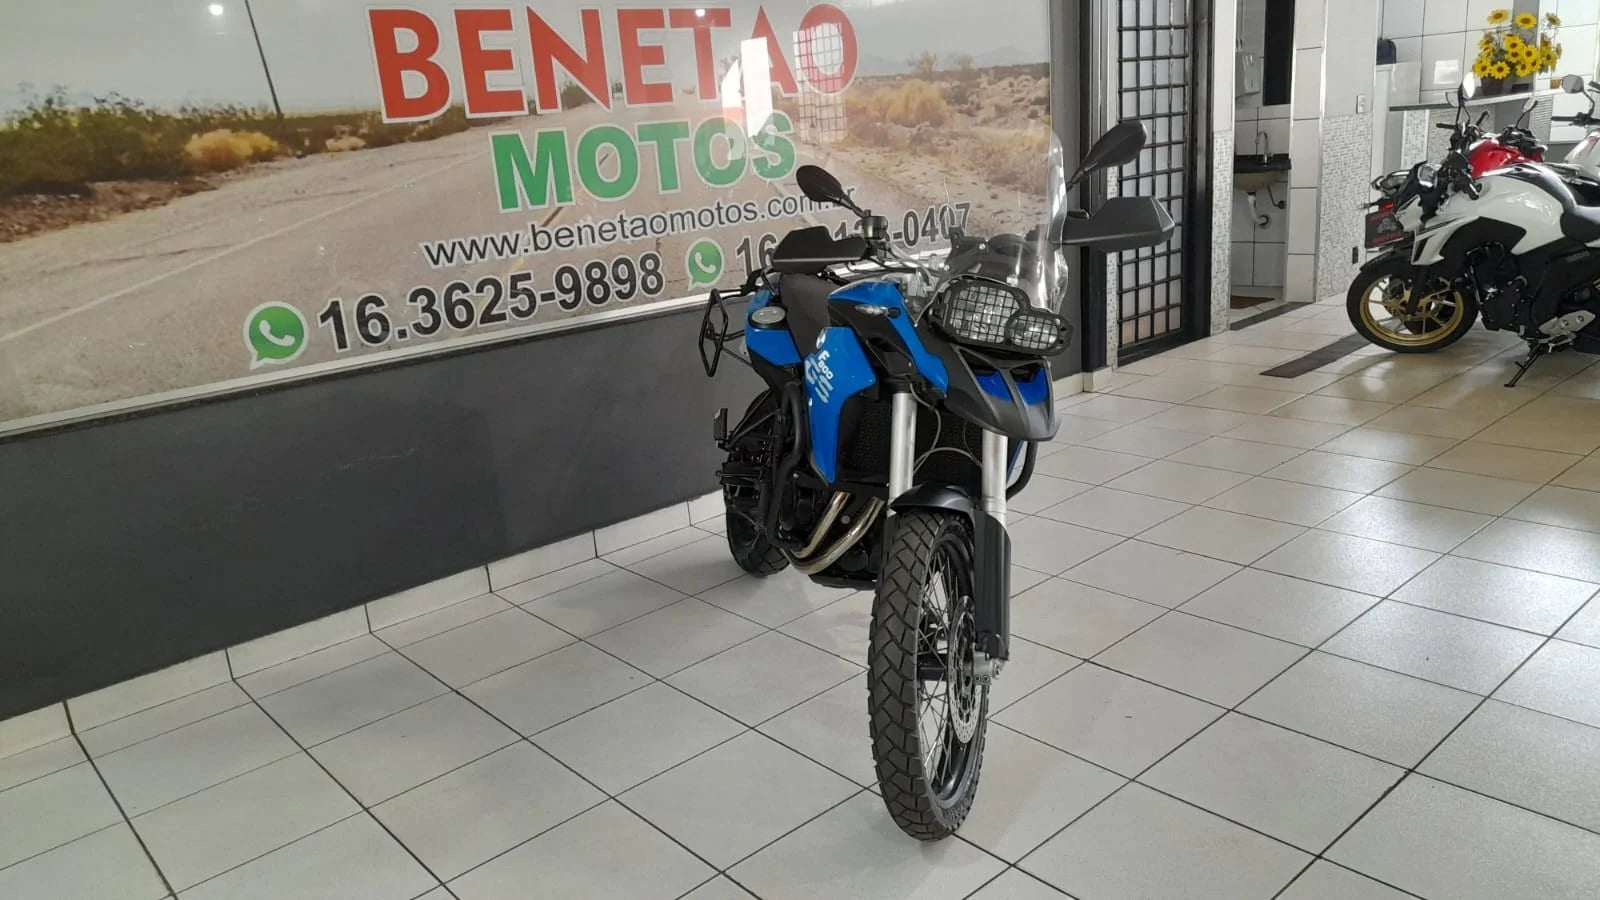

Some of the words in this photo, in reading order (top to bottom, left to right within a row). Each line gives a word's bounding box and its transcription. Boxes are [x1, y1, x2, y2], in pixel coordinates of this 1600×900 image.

[368, 4, 858, 121] BENETAO
[490, 113, 796, 211] MOTOS
[424, 187, 855, 266] www.benetaomotos.com.r
[318, 252, 663, 350] 16.3625-9898
